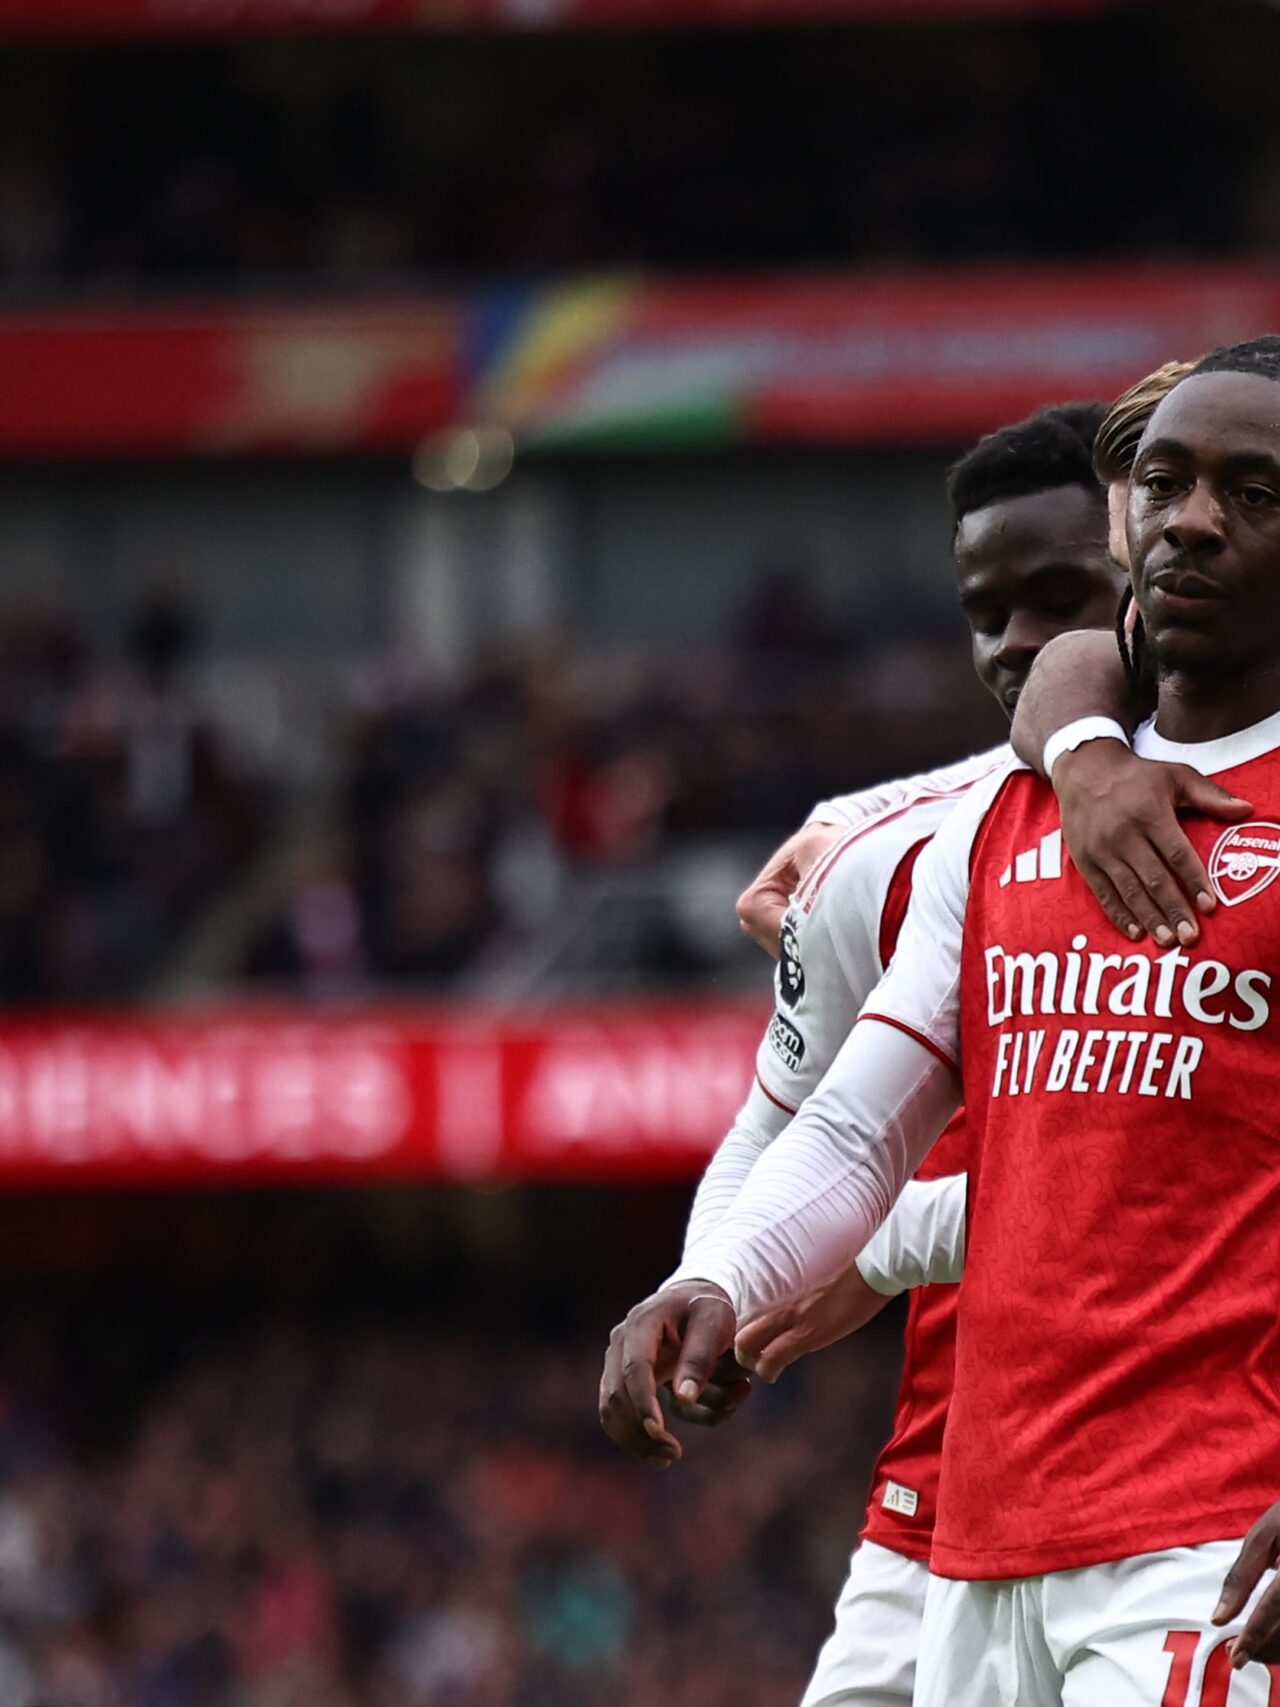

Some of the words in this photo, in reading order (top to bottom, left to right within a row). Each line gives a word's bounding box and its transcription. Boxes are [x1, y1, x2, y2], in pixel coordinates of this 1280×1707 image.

[984, 934, 1272, 1031] Emirates
[991, 1029, 1046, 1099] FLY
[1045, 1029, 1204, 1100] BETTER
